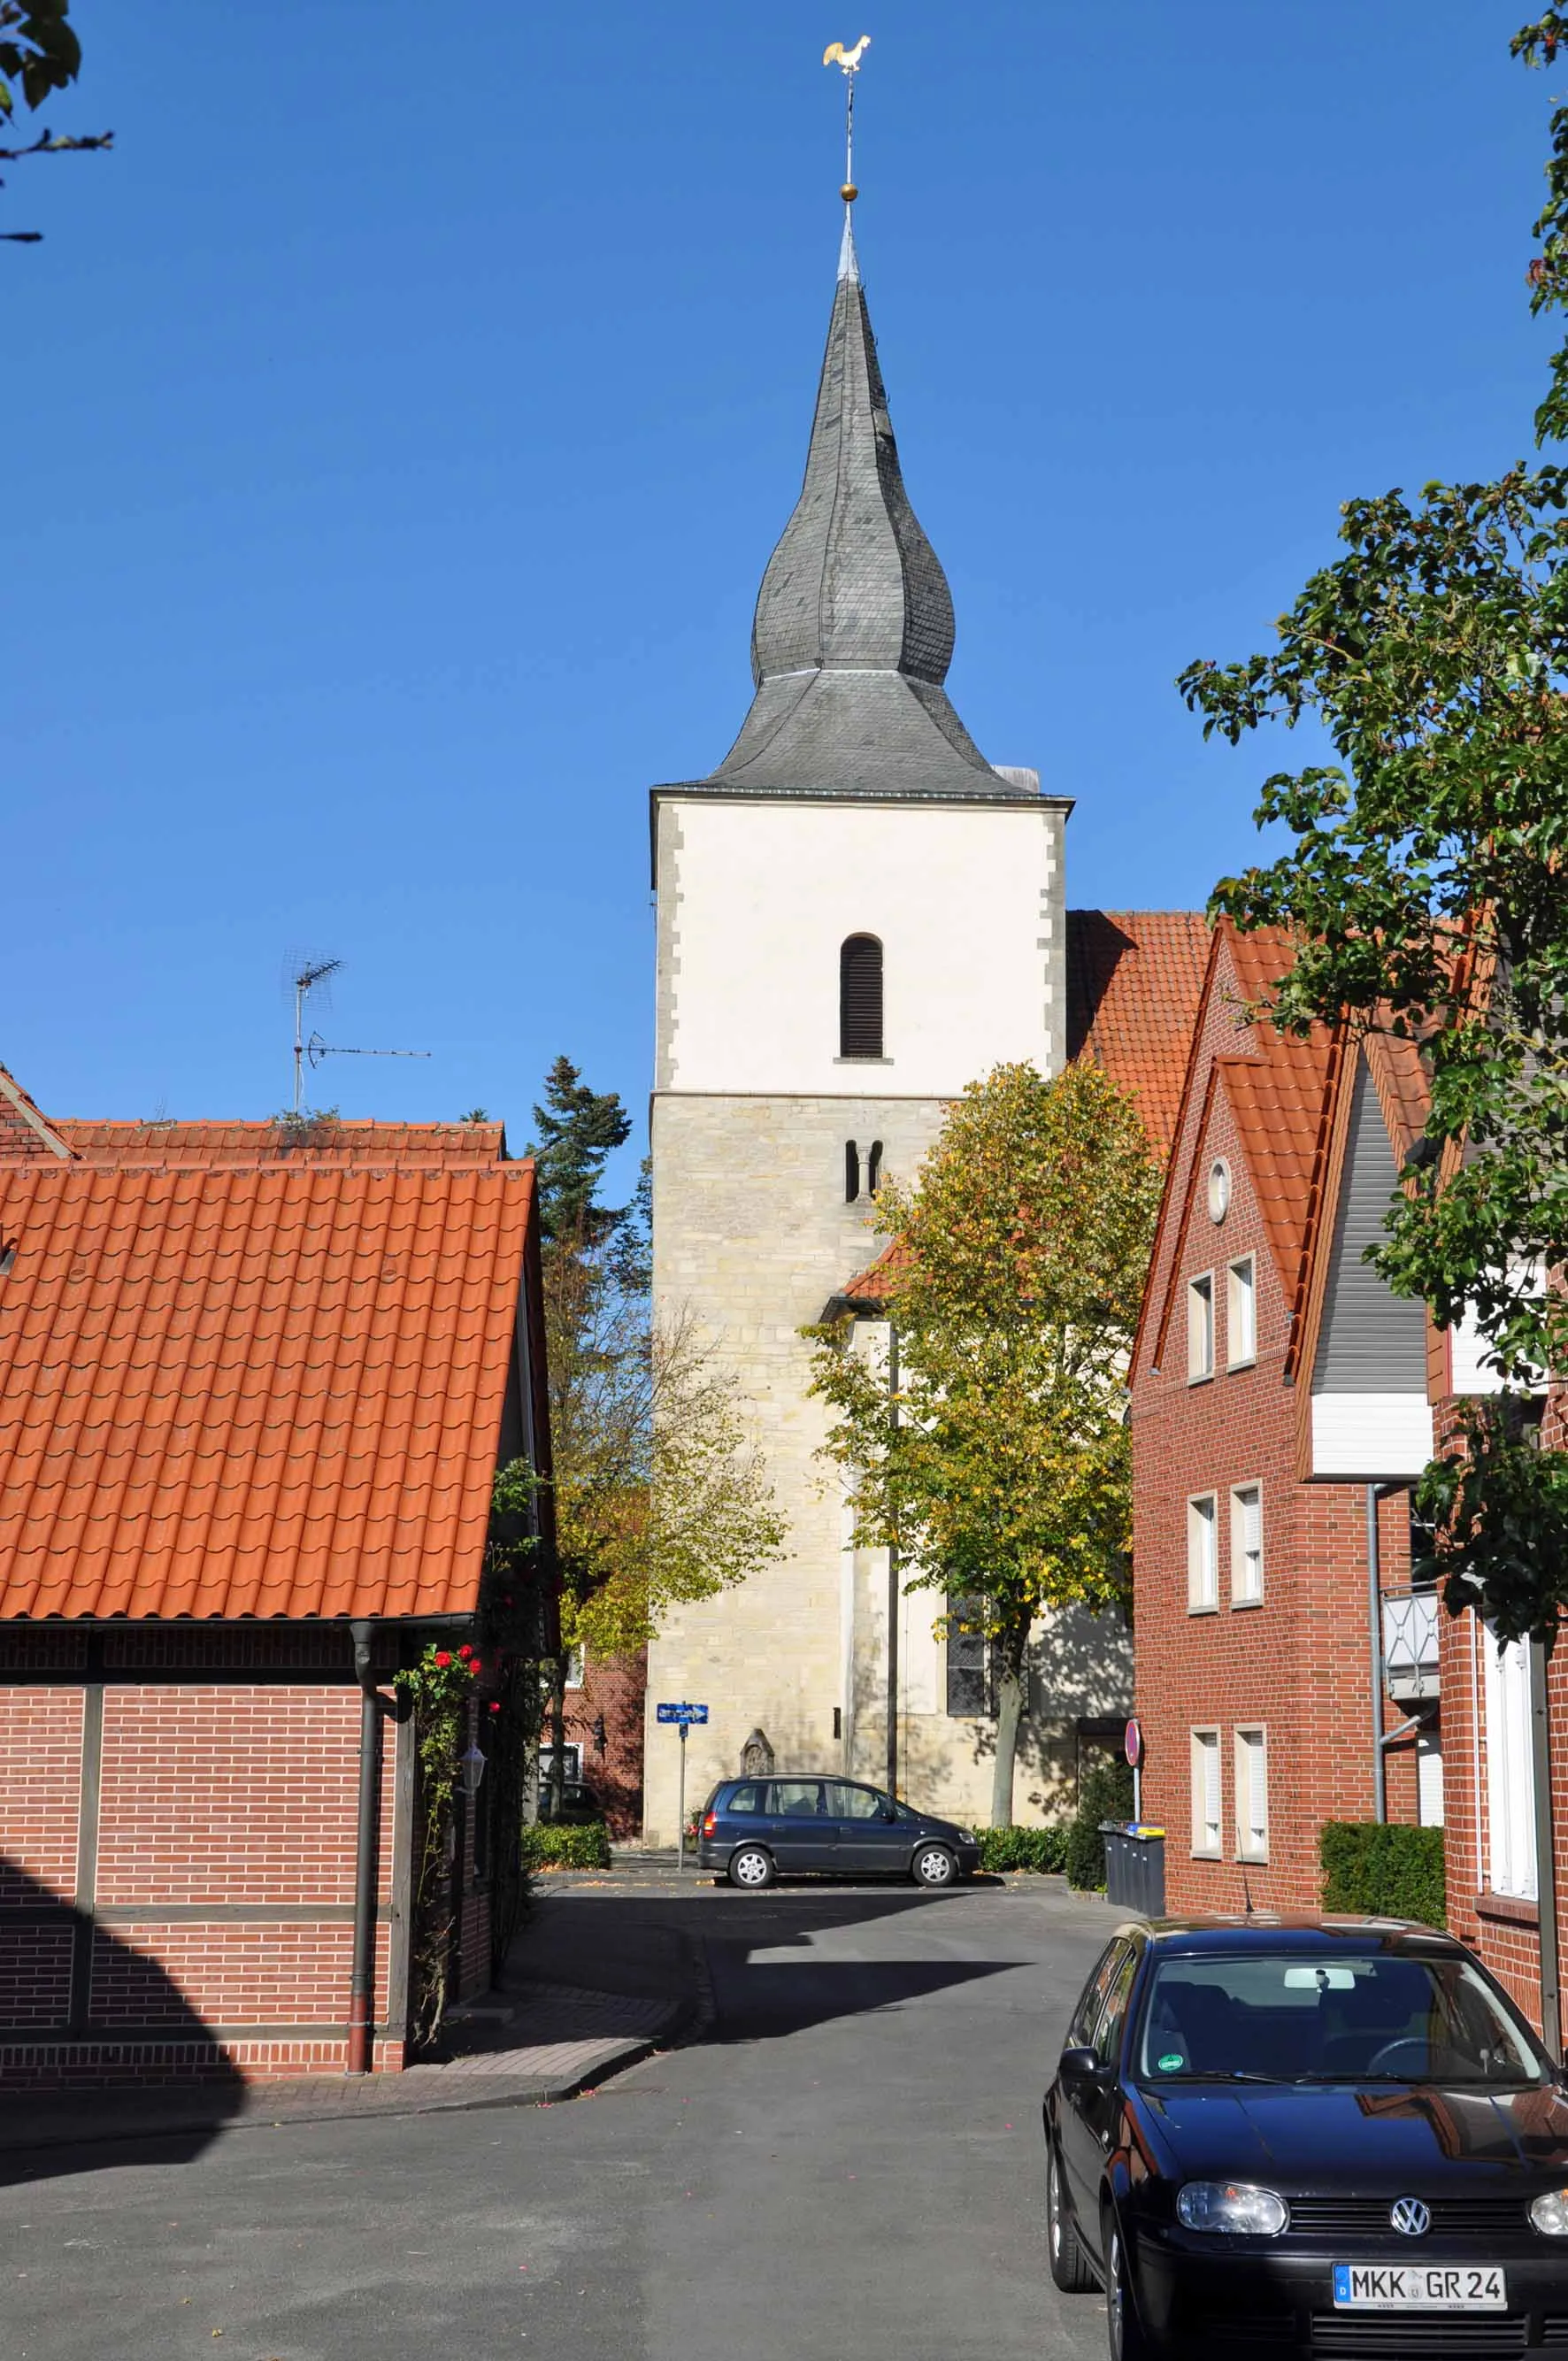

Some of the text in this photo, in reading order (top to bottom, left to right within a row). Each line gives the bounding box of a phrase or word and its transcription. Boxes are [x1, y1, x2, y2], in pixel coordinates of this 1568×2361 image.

[1392, 2197, 1430, 2235] VW
[1352, 2271, 1406, 2298] MKK
[1426, 2272, 1461, 2298] GR
[1467, 2272, 1500, 2299] 24
